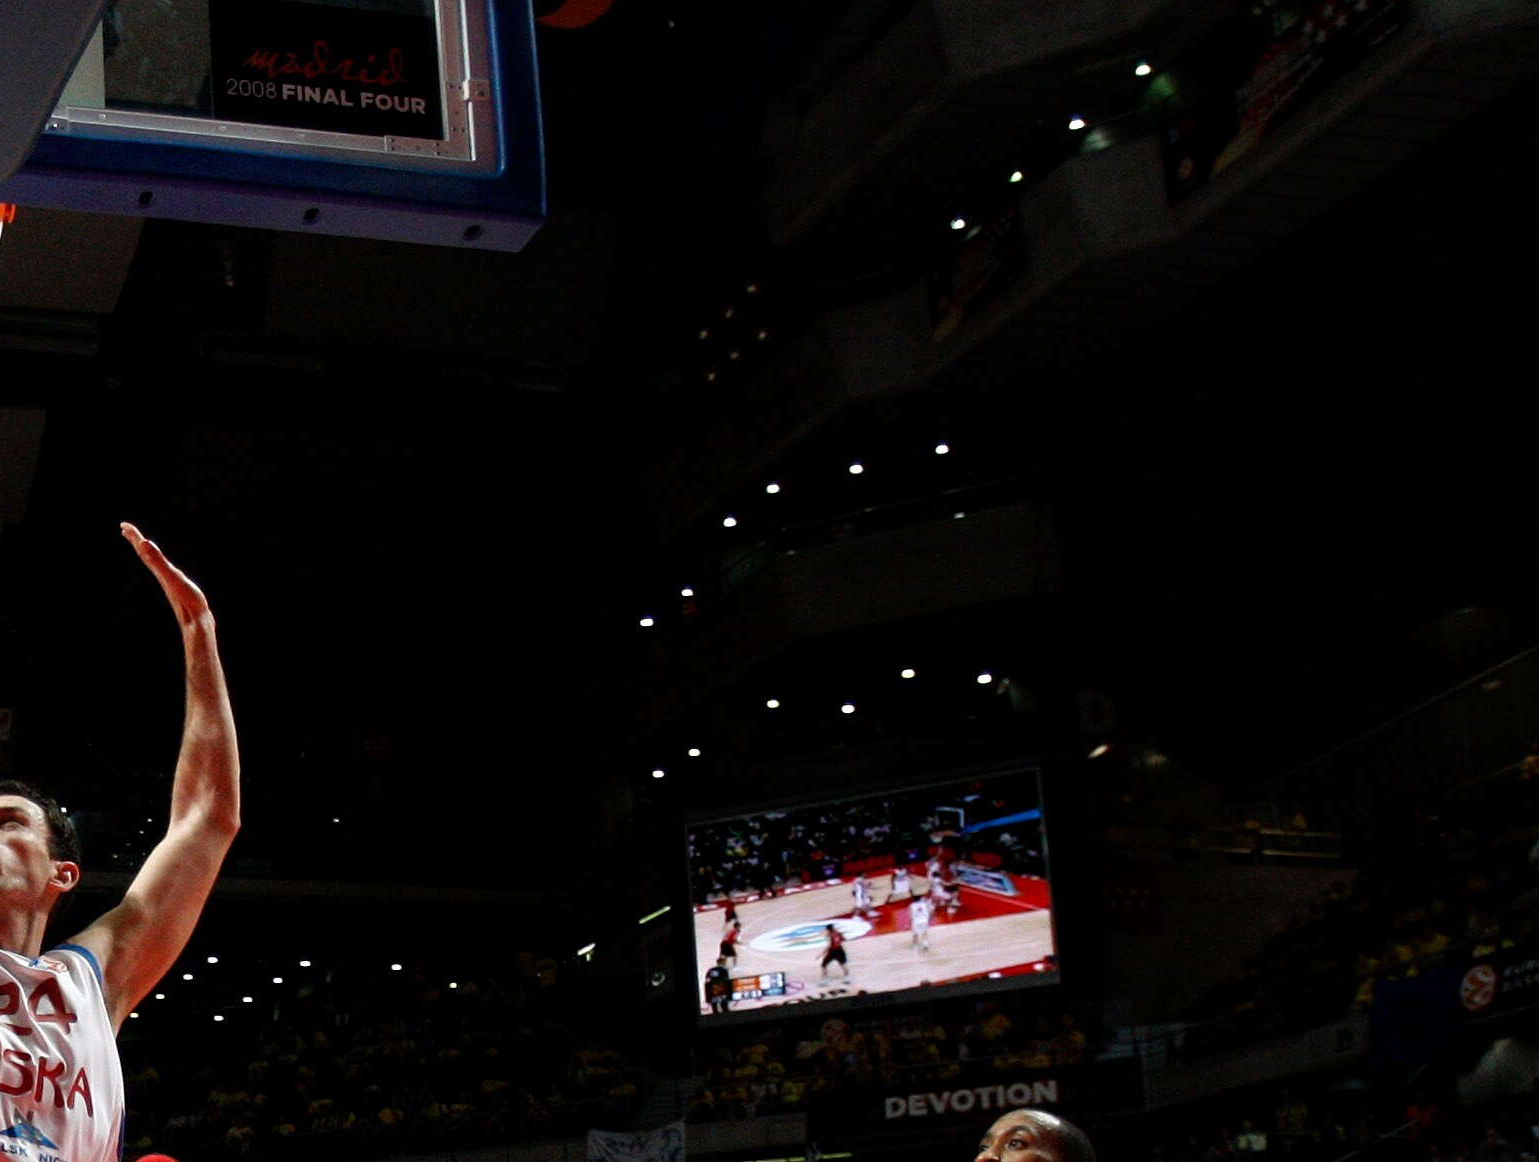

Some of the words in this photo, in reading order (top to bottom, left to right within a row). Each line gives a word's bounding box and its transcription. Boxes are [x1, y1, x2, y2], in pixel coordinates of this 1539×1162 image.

[243, 38, 411, 87] madrid
[226, 78, 278, 99] 2008
[282, 84, 354, 107] FINAL
[360, 91, 427, 114] FOUR
[884, 1079, 1060, 1120] DEVOTION
